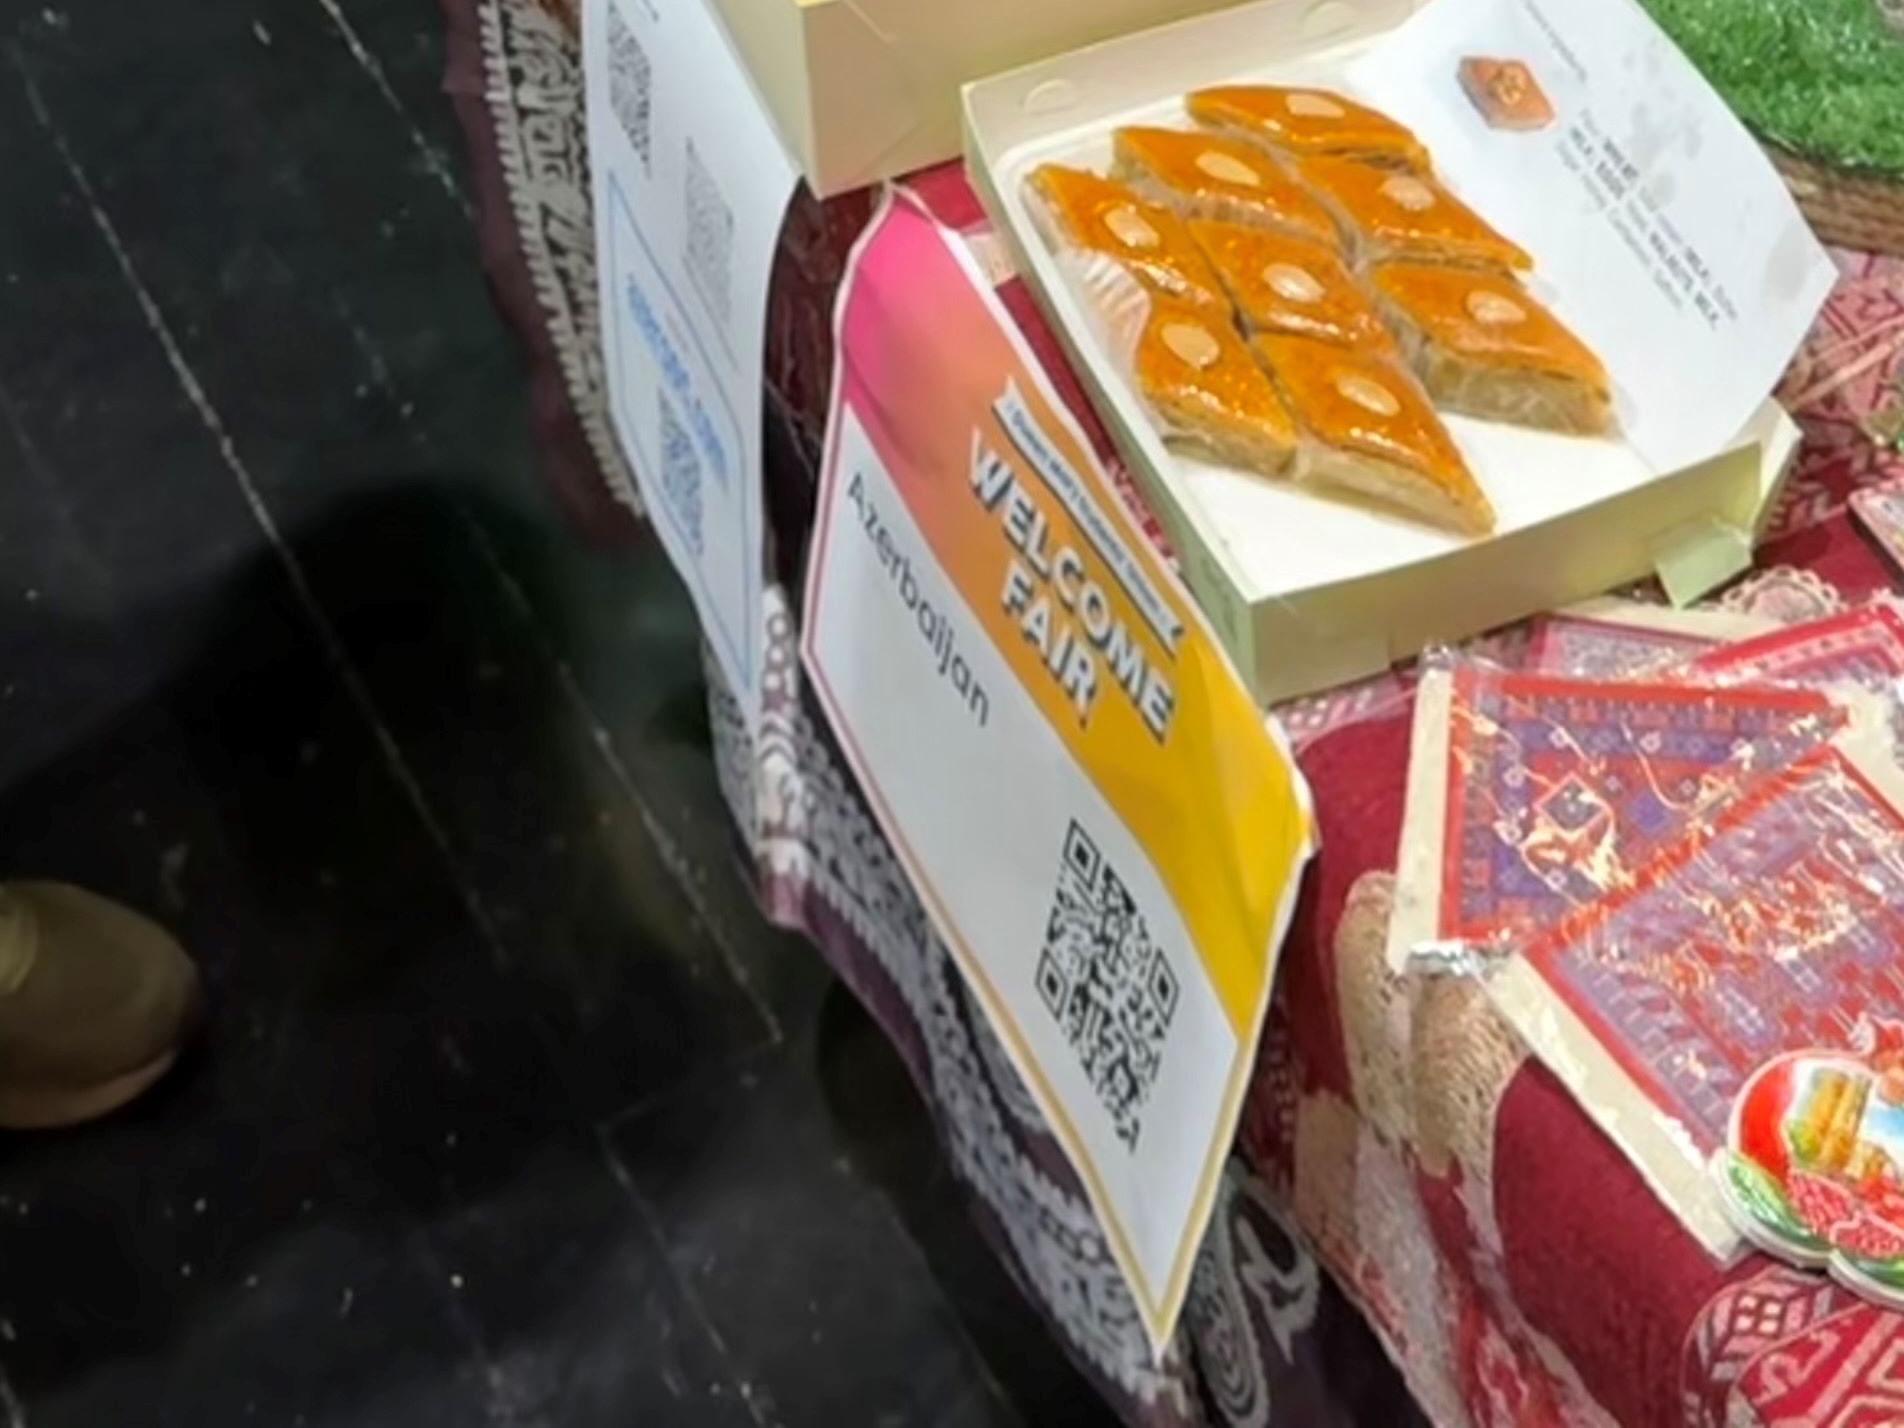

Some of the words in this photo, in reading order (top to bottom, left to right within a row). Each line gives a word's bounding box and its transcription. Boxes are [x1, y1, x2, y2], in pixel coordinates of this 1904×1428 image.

[847, 471, 990, 728] Azerbaijan
[970, 426, 1175, 744] WELCOME
[1002, 558, 1097, 722] FAIR
